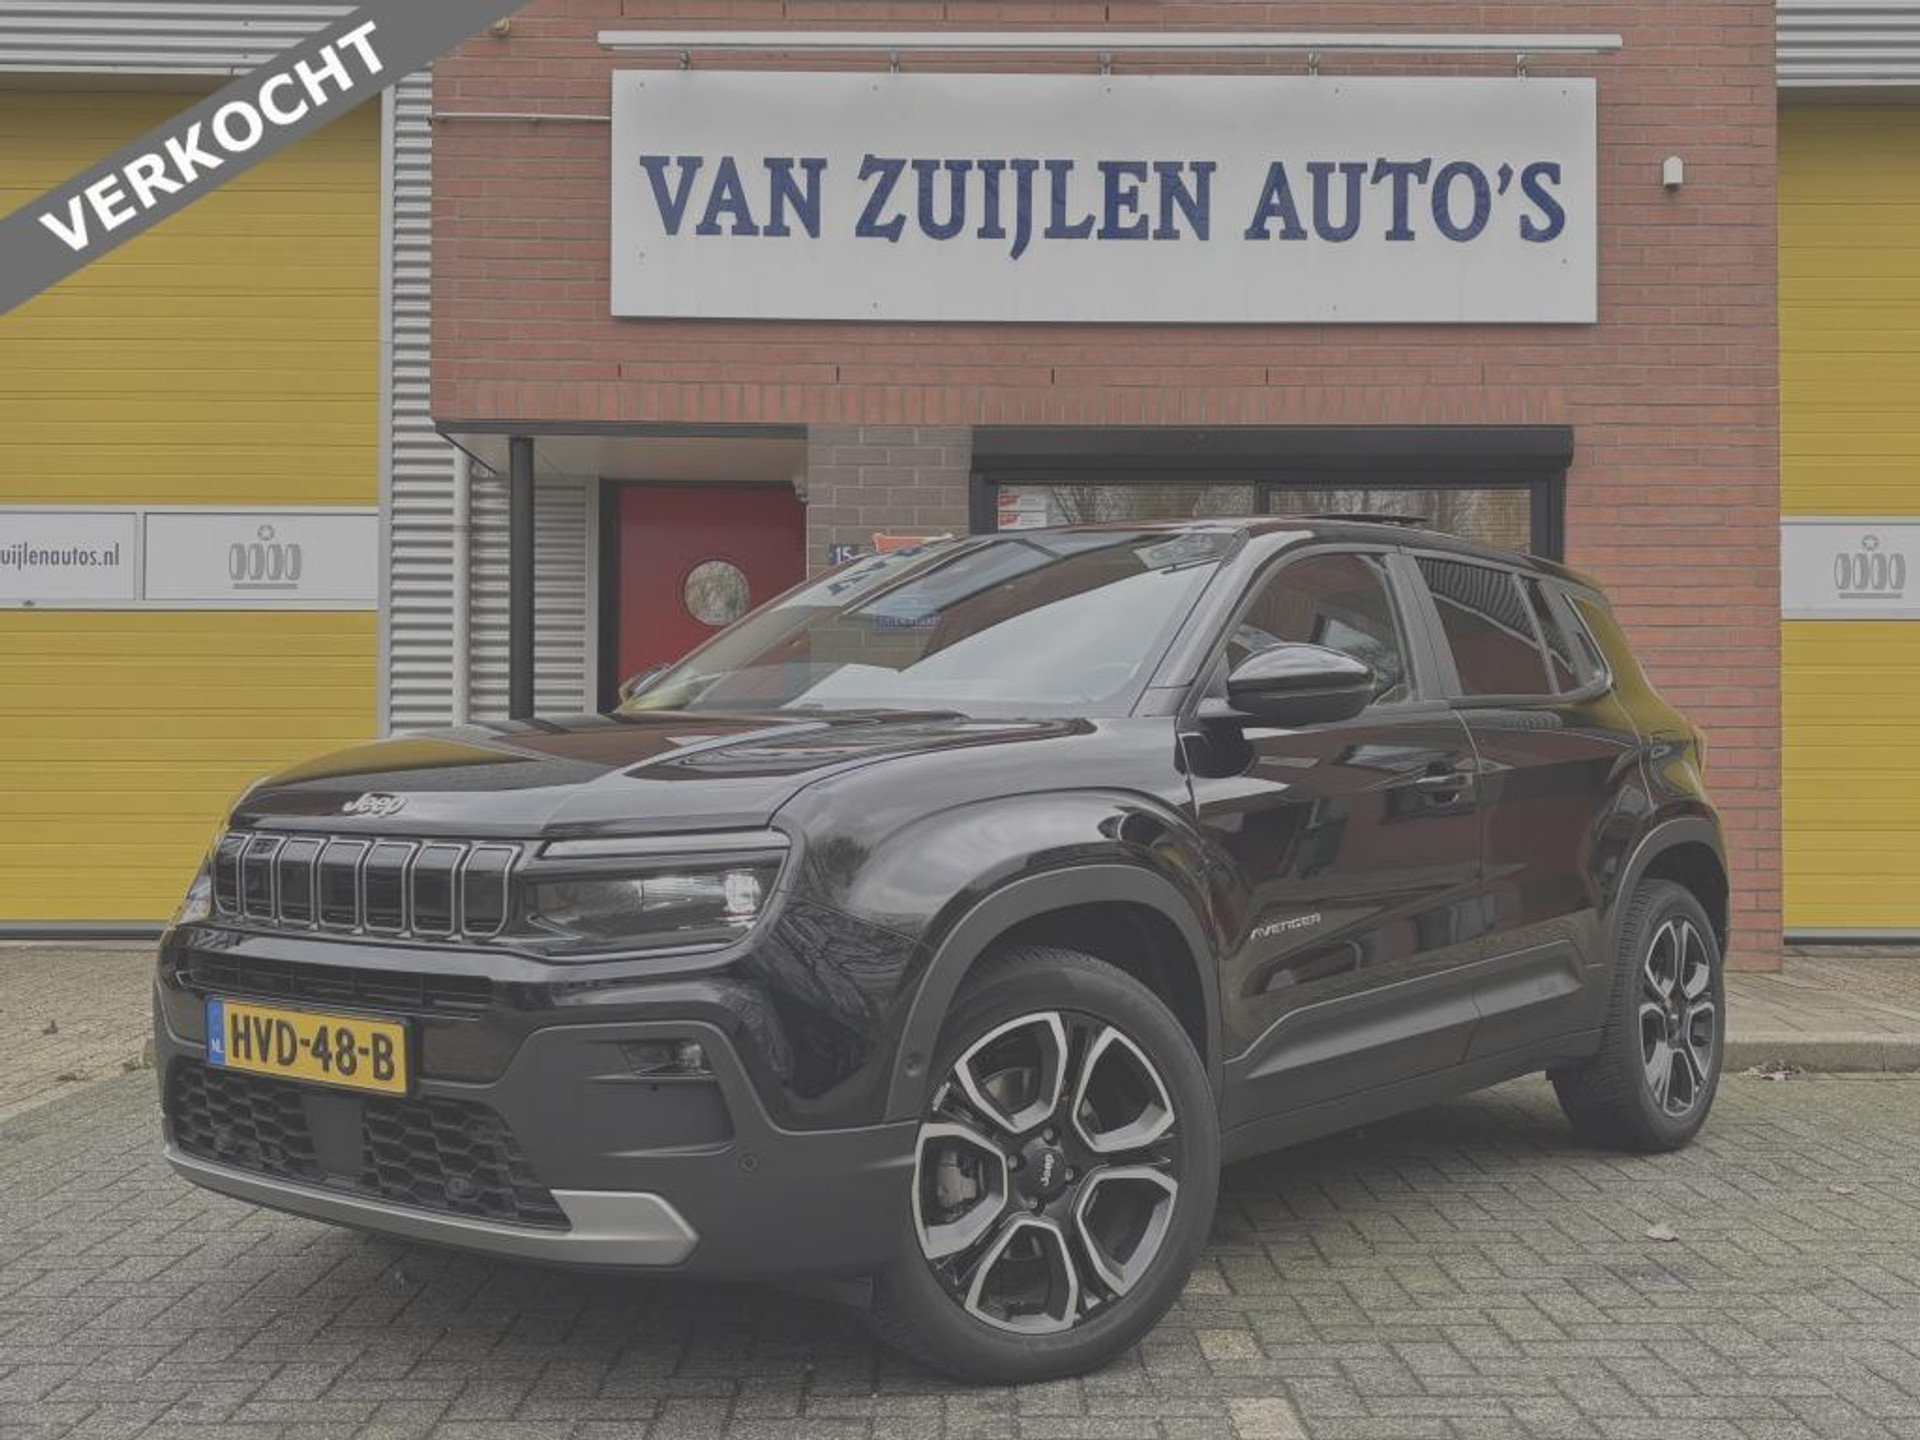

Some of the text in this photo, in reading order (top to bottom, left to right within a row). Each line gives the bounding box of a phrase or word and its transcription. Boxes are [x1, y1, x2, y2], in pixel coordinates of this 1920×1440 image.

[639, 153, 1567, 260] VAN ZUIJLEN AUTO'S
[343, 792, 407, 817] Jeep
[1250, 912, 1321, 941] AVENGER
[231, 1013, 395, 1081] HVD-48-B
